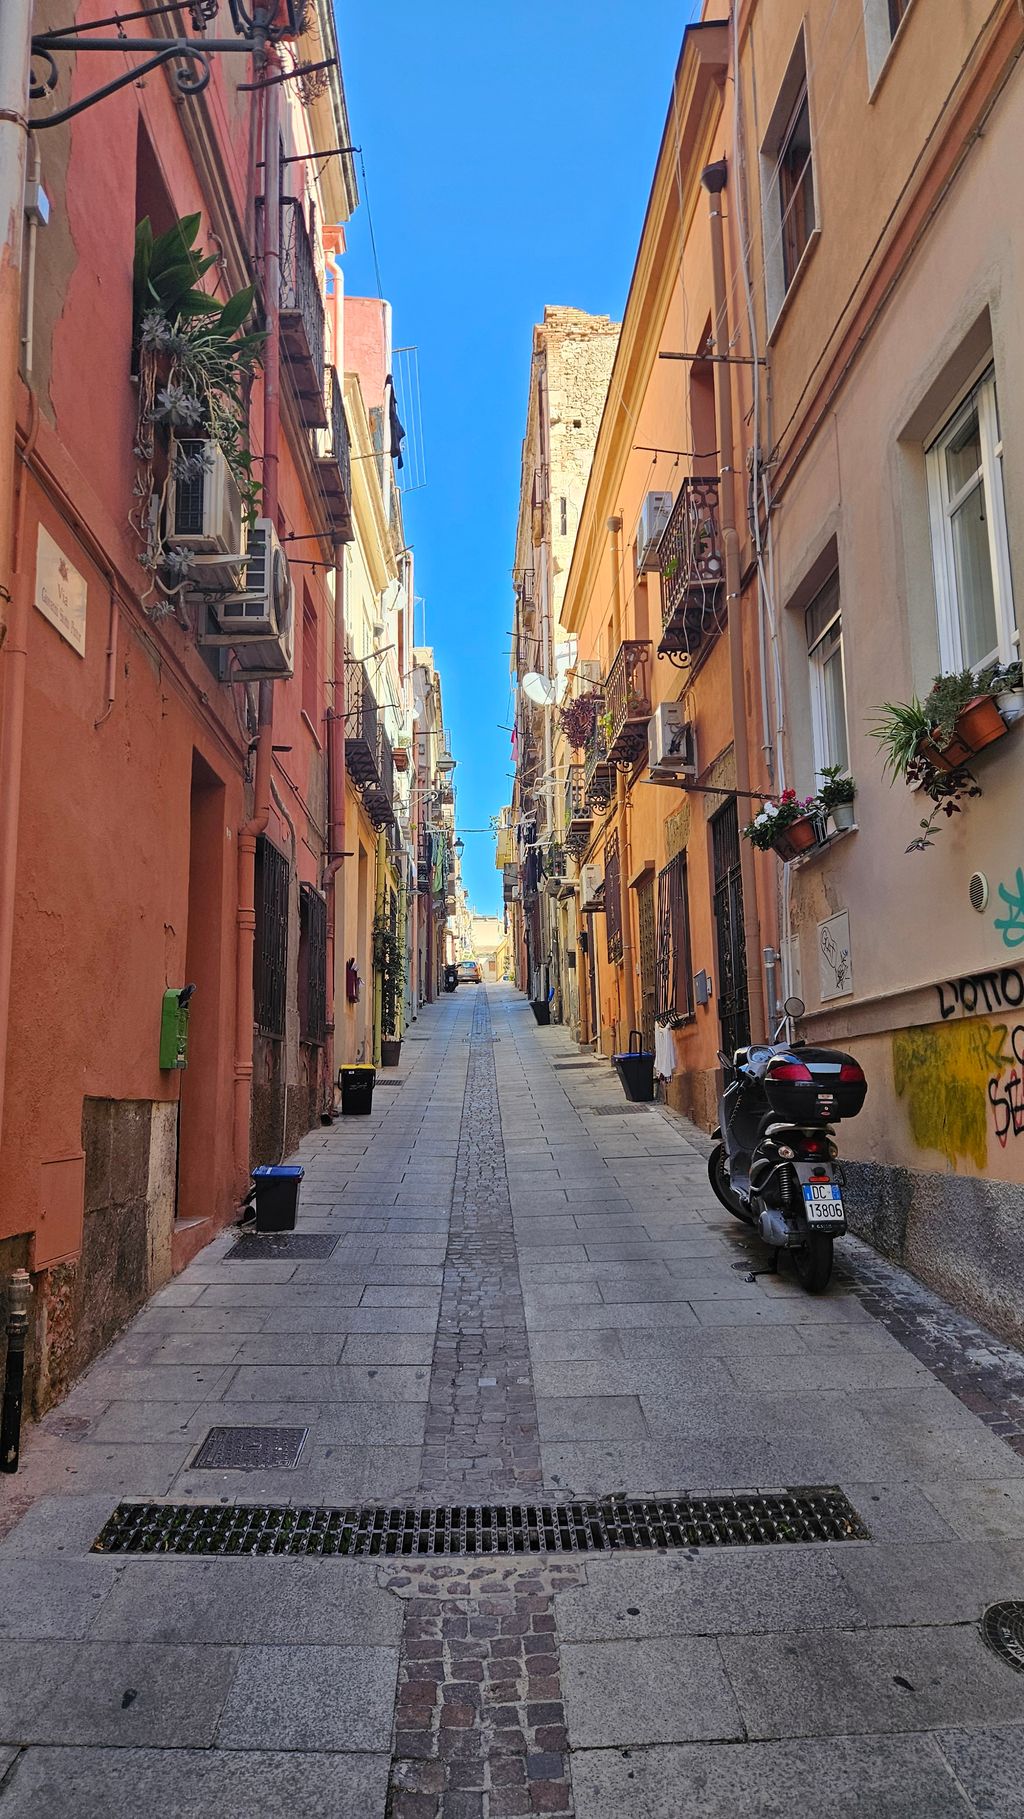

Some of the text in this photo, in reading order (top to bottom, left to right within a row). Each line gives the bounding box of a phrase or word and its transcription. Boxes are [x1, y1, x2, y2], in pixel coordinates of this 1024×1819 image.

[57, 583, 69, 607] Via
[812, 1185, 827, 1200] DC
[808, 1203, 843, 1218] 13806
